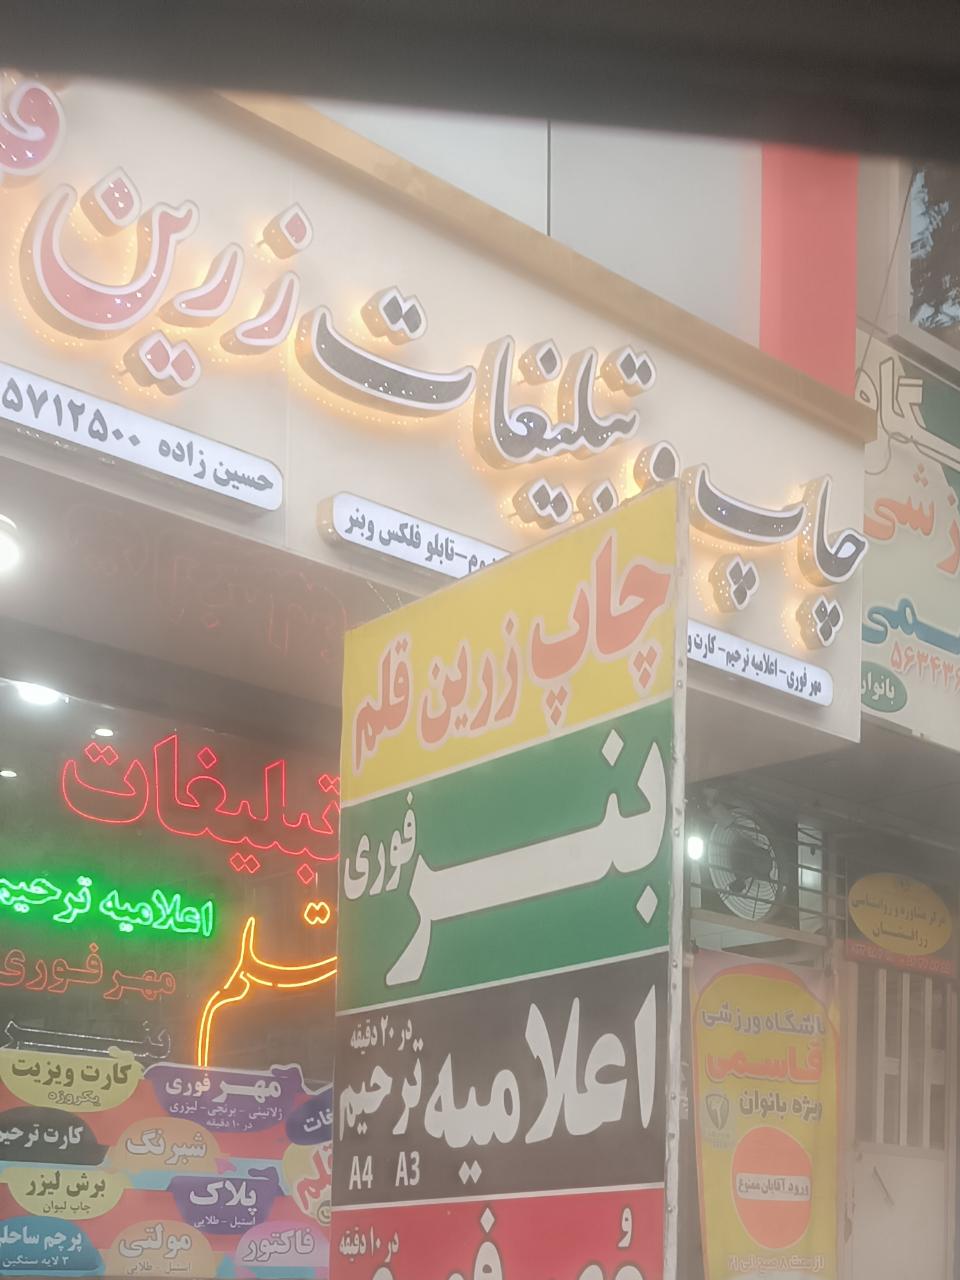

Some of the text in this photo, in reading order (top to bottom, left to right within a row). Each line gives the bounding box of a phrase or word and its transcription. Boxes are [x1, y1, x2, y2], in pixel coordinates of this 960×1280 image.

[24, 168, 869, 650] چاپ تبلیغات زرین
[2, 377, 275, 491] حسین زاده ۵۷۱۲۵۰۰
[378, 522, 423, 549] فلکس
[425, 533, 455, 564] تابلو
[354, 535, 672, 771] چاپ زرین قلم
[693, 633, 717, 659] کارت
[725, 647, 750, 672] ترحیم
[750, 653, 778, 677] اعلامیه
[786, 667, 808, 692] فوری
[808, 680, 822, 697] مهر
[62, 734, 341, 885] تبلیغات
[344, 790, 417, 901] فوری
[386, 728, 668, 987] بنر
[99, 889, 213, 936] اعلامیه
[0, 942, 176, 1000] مهر فوری
[350, 1015, 413, 1053] در ۲۰ دقیقه
[701, 1001, 761, 1035] ورزشی
[11, 1059, 132, 1090] کارت ویزیت
[705, 1042, 822, 1084] قاسمی
[165, 1073, 282, 1104] مهر فوری
[338, 1038, 424, 1142] ترحیم
[423, 983, 658, 1185] اعلامیه
[169, 1100, 198, 1114] لیزری
[207, 1105, 237, 1118] برنجی
[740, 1089, 787, 1120] بانوان
[43, 1125, 84, 1150] کارت
[206, 1119, 230, 1129] دقیقه
[242, 1122, 254, 1131] در
[25, 1170, 107, 1198] برش لیزر
[349, 1151, 421, 1190] A4 A3
[189, 1180, 257, 1215] پلاک
[230, 1216, 256, 1229] استیل
[43, 1230, 83, 1253] پرچم
[119, 1222, 193, 1259] مولتی
[242, 1228, 315, 1263] فاکتور
[339, 1226, 400, 1263] در ۱۰ دقیقه
